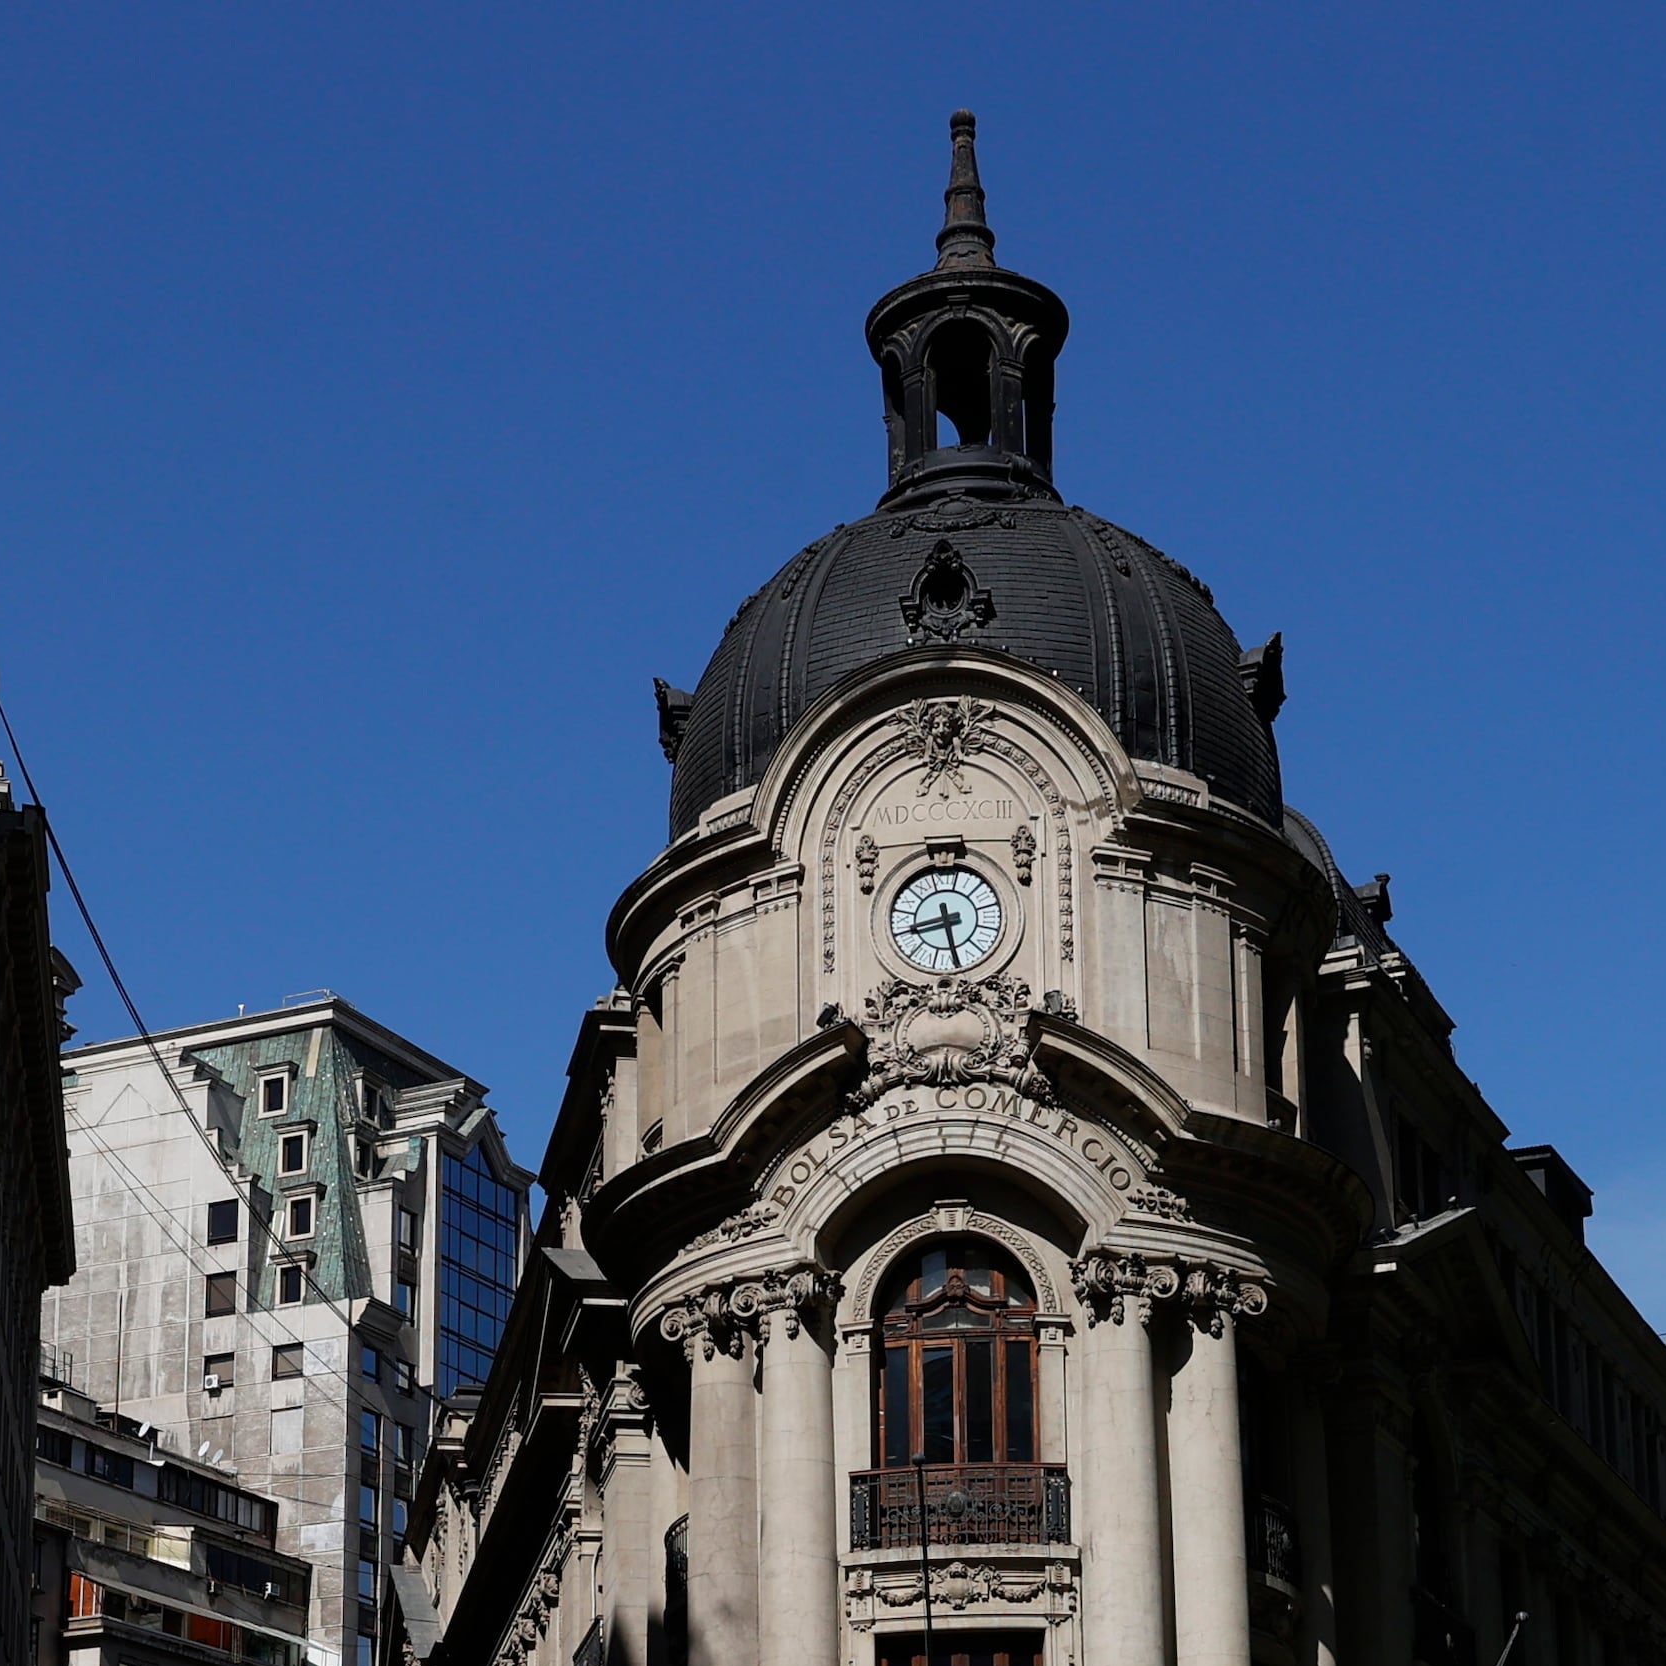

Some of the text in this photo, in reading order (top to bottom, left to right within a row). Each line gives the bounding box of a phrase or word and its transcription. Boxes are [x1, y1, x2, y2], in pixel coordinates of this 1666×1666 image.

[872, 800, 1014, 827] MDCCCXCIII
[901, 896, 915, 909] X
[976, 891, 990, 903] II
[983, 911, 996, 924] III
[771, 1086, 1133, 1211] BOLSA DE COMERCIO
